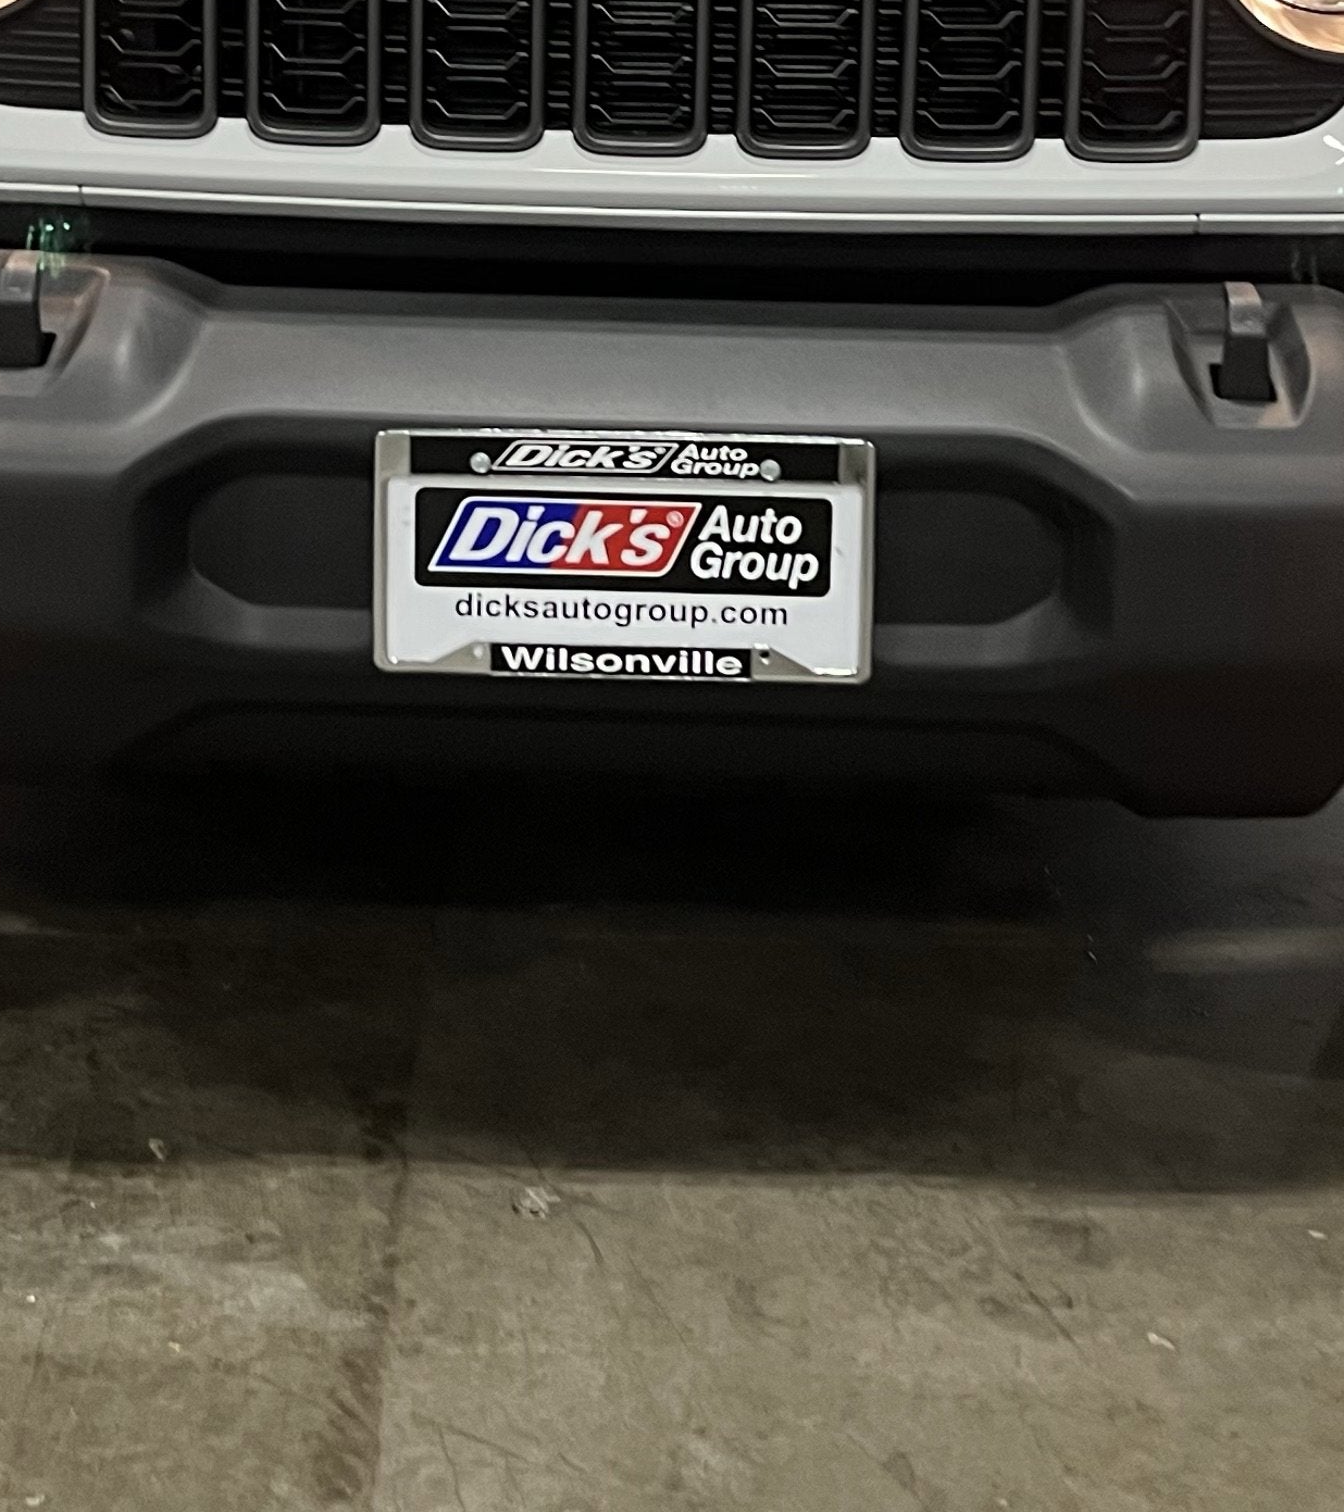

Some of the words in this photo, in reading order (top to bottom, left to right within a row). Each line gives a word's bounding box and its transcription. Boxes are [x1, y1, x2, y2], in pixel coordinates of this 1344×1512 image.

[505, 444, 658, 469] Dick's
[671, 458, 760, 479] Group
[678, 443, 748, 461] Auto
[449, 504, 671, 566] Dick's
[698, 505, 802, 545] Auto
[690, 541, 819, 589] Group
[455, 593, 789, 629] dicksautogroup.com
[501, 645, 743, 675] Wilsonville
